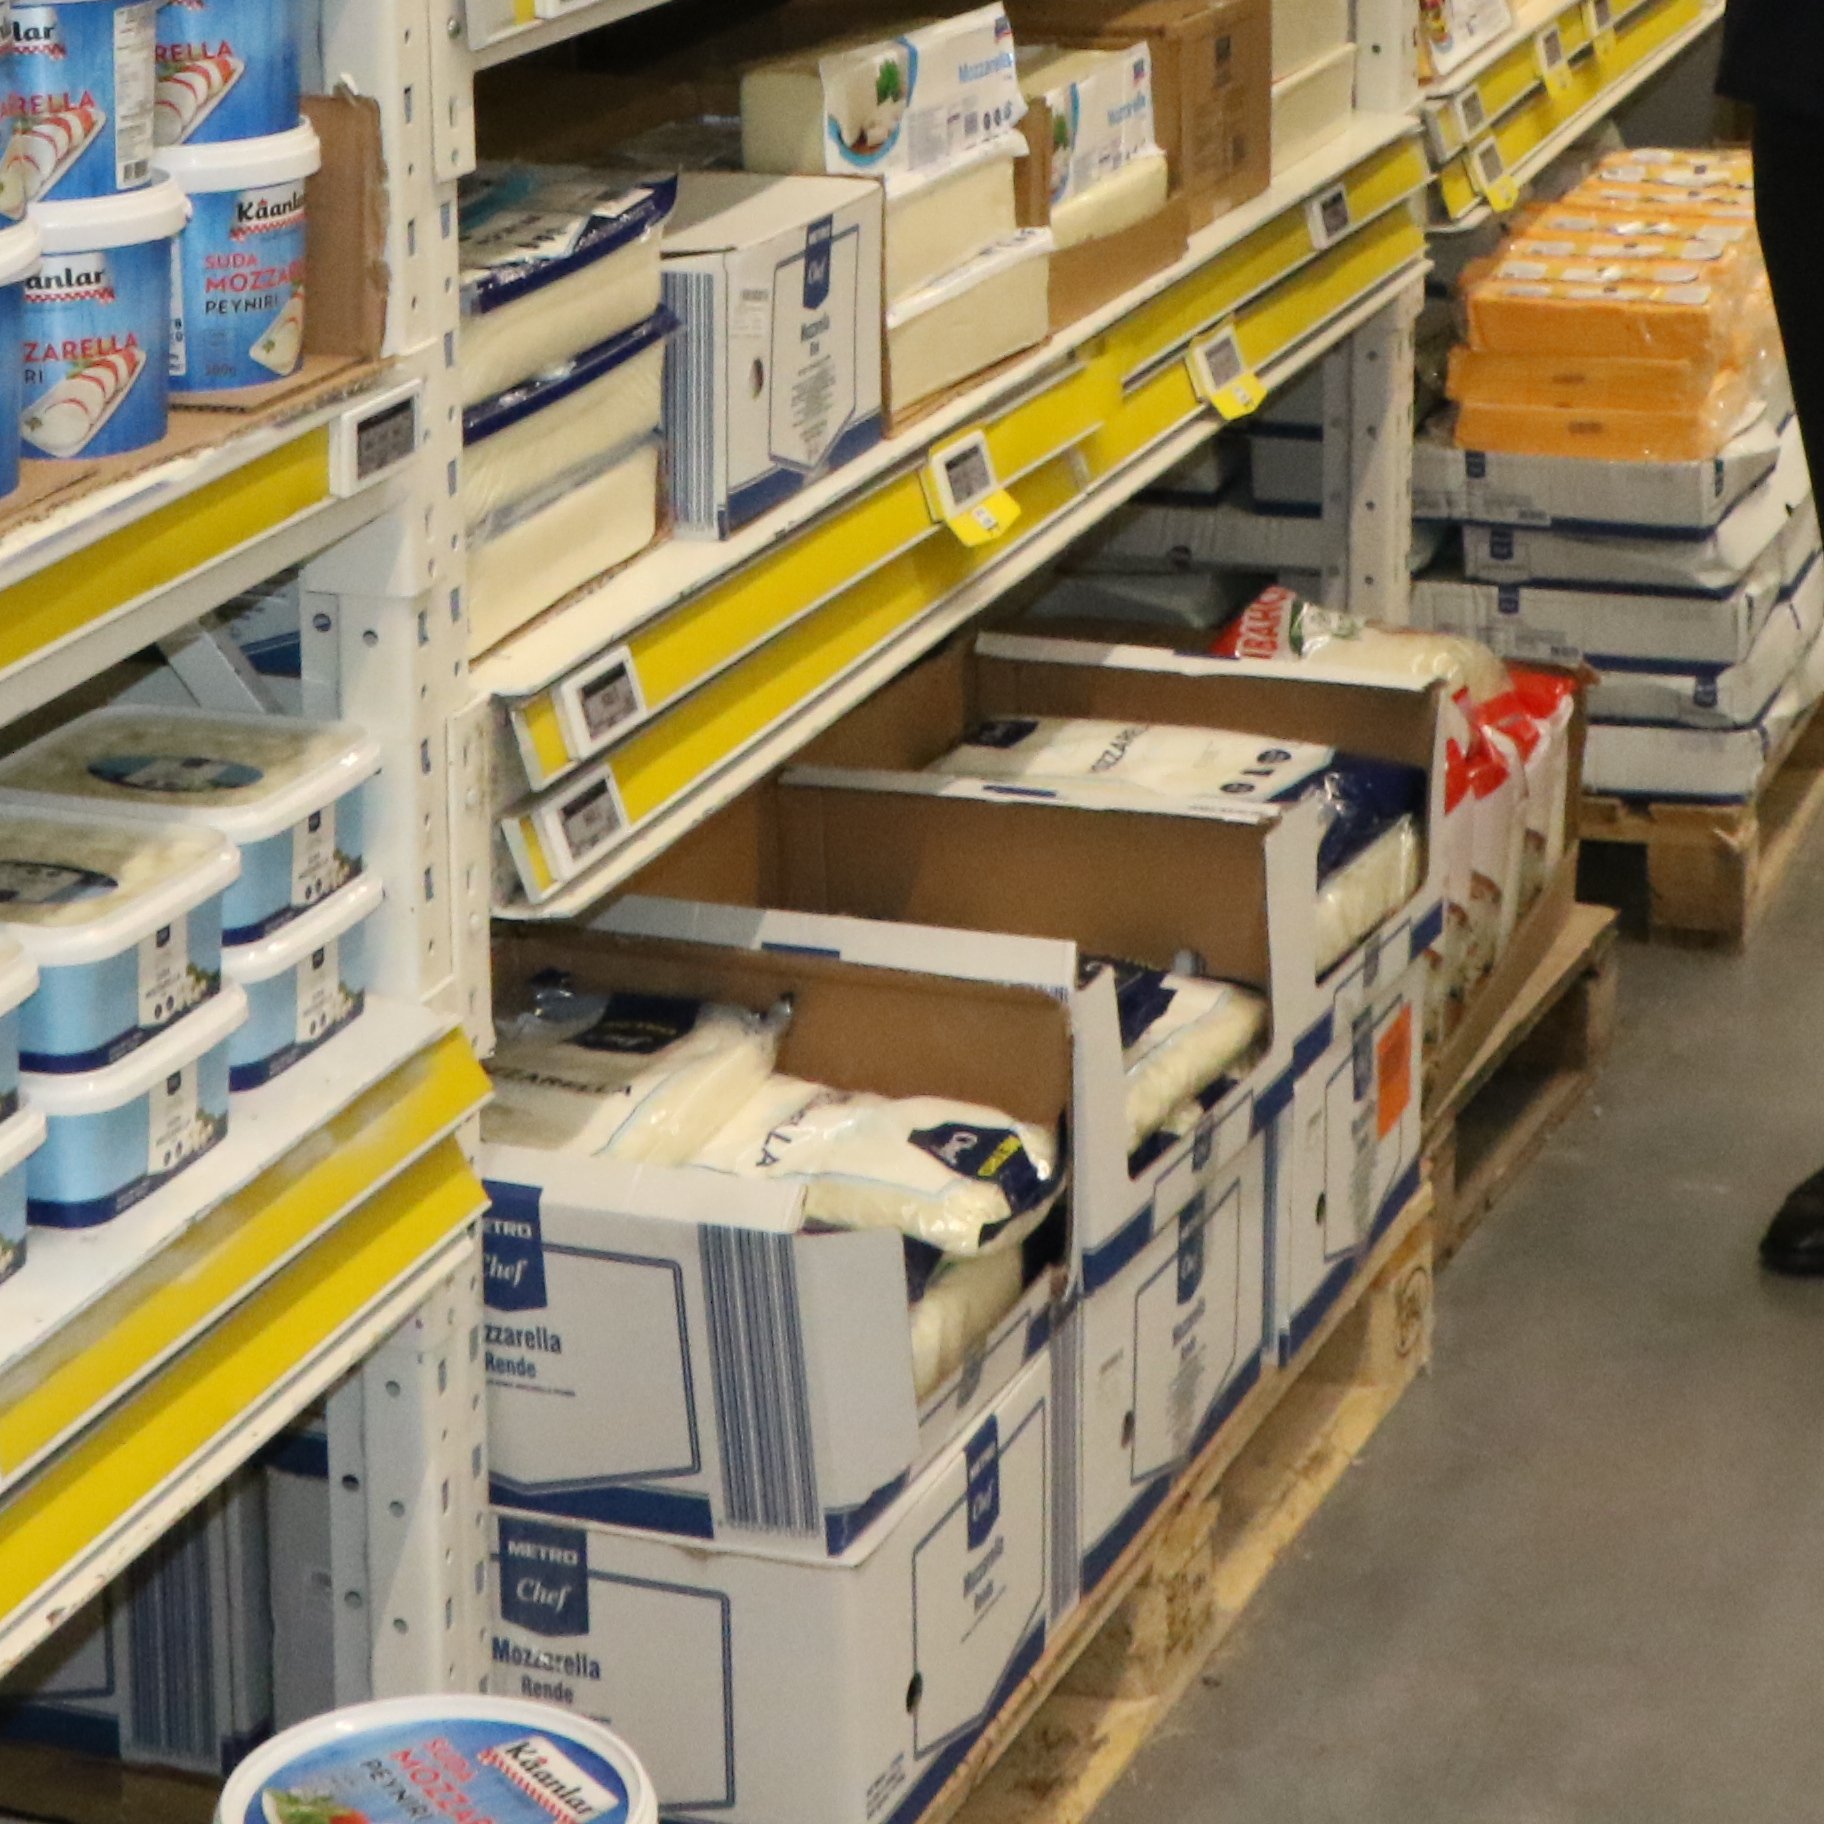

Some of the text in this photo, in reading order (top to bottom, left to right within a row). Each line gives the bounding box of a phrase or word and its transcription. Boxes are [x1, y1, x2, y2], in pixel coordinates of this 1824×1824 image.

[205, 254, 258, 272] SUDA
[485, 1352, 537, 1377] Rende
[508, 1540, 578, 1564] METRO
[516, 1578, 572, 1614] Chef
[492, 1636, 601, 1681] Mozzarella
[521, 1675, 574, 1704] Rende
